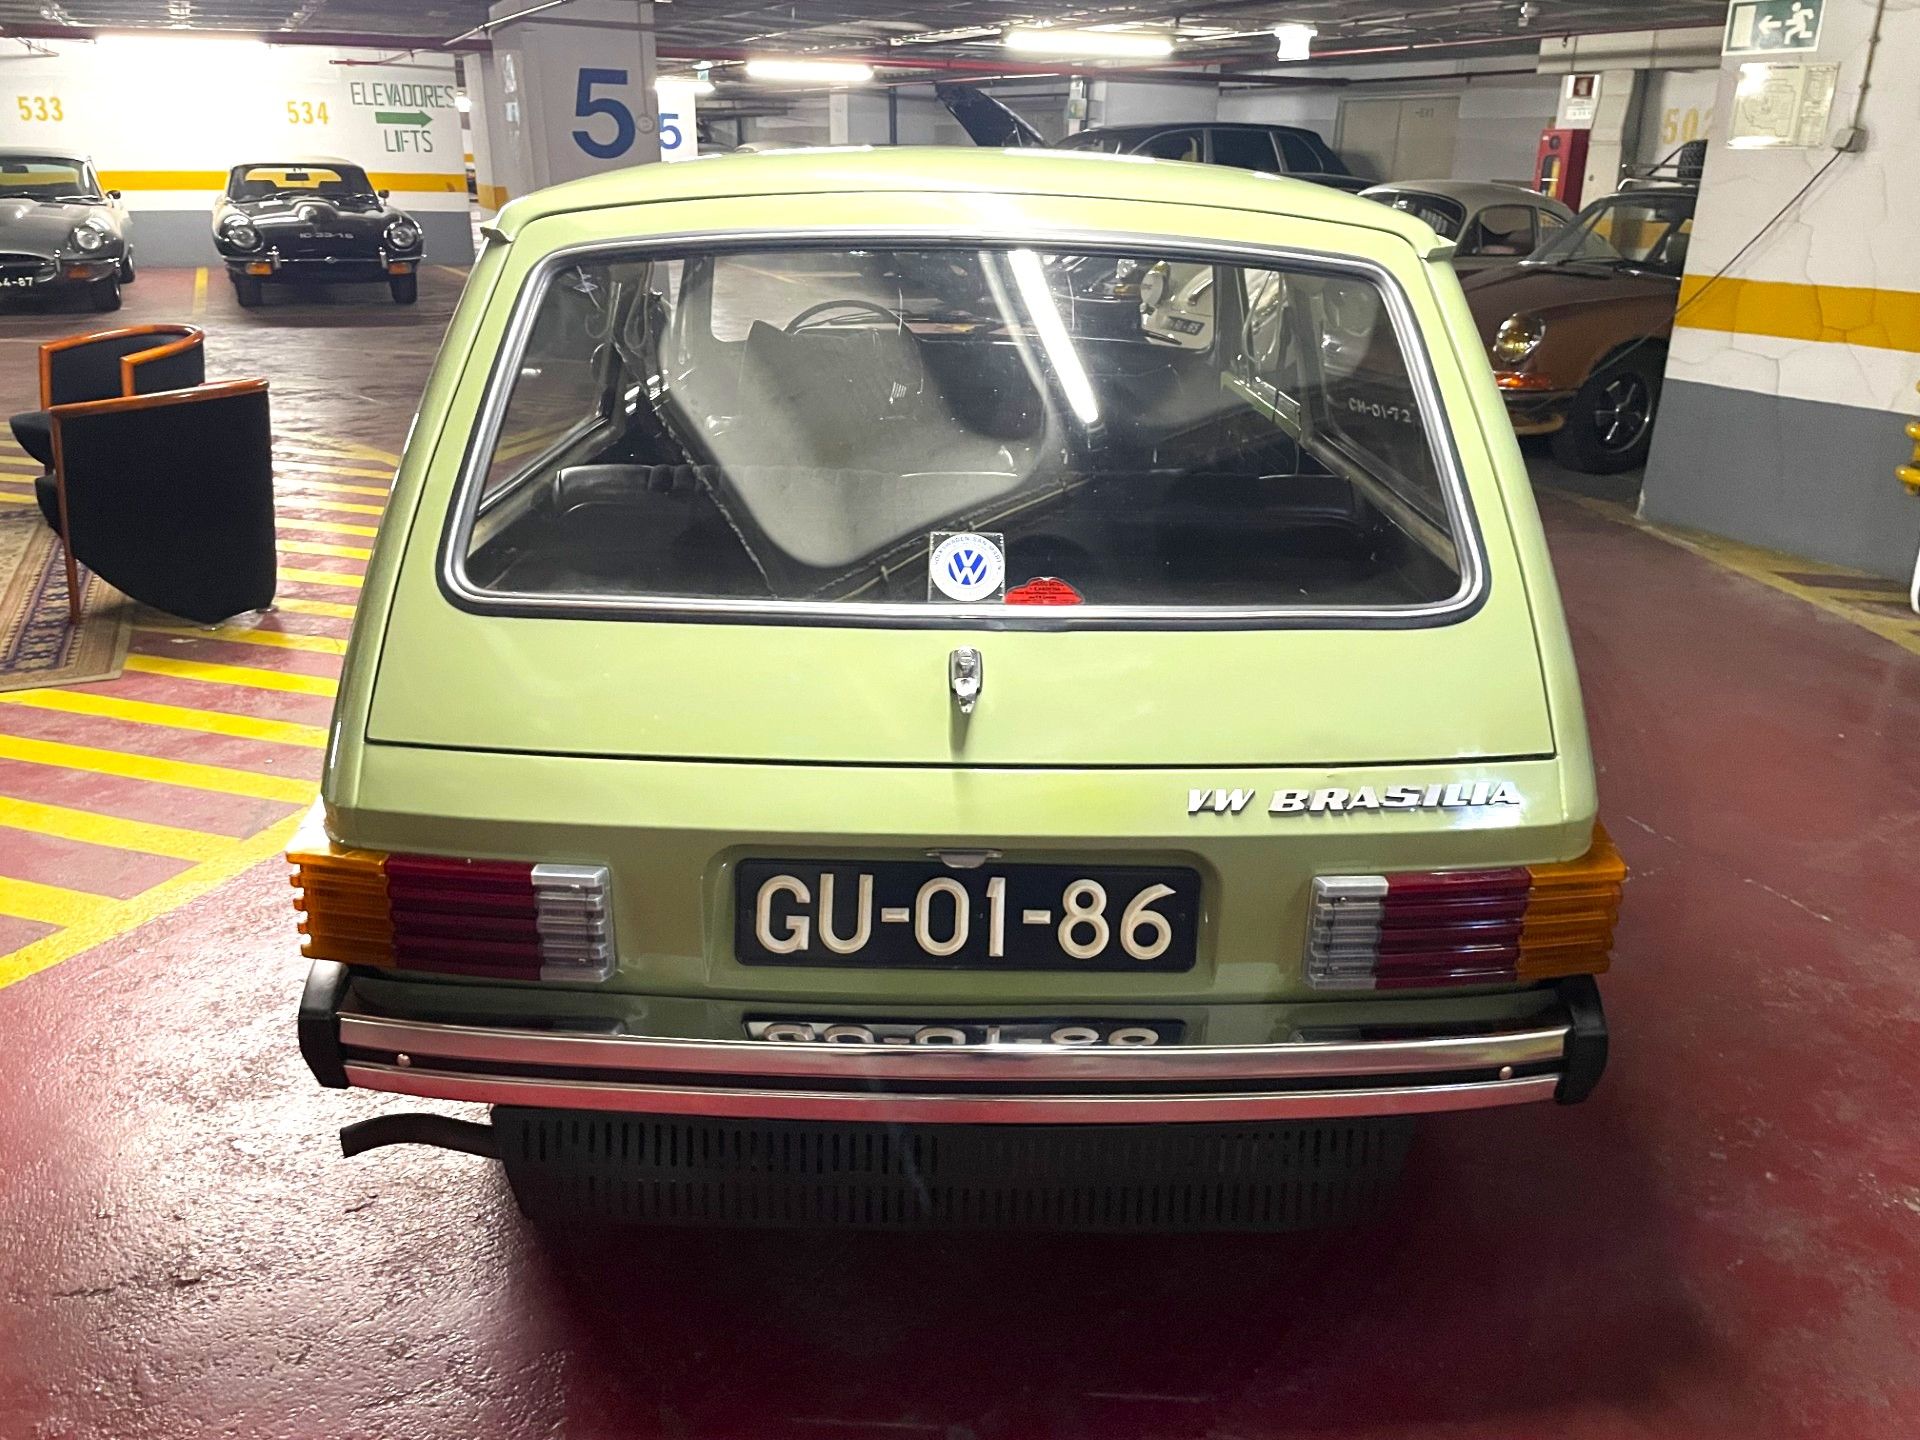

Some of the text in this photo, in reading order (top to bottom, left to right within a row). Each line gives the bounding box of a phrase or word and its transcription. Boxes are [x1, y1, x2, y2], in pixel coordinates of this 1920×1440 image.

[17, 96, 64, 121] 533
[350, 81, 456, 108] ELEVADORES
[287, 100, 329, 125] 534
[572, 68, 636, 159] 5
[384, 129, 434, 152] LIFTS
[659, 113, 683, 150] 5
[1187, 781, 1523, 817] VW BRASILIA
[755, 873, 1177, 961] GU-01-86
